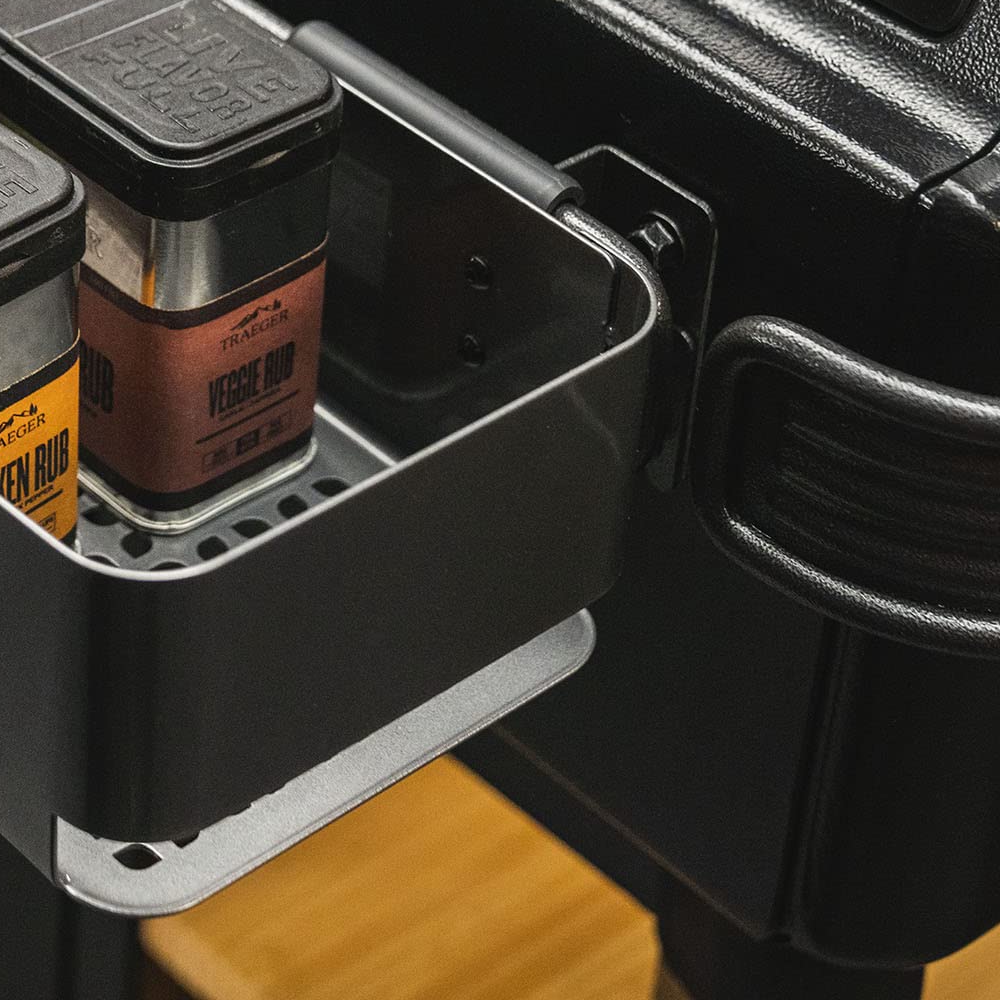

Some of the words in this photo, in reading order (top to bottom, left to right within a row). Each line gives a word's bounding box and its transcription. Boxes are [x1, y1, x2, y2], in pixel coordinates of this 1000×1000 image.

[219, 309, 289, 351] TRAEGER
[209, 356, 261, 418] VEGGIE
[264, 341, 296, 391] RUB
[34, 427, 69, 492] RUB
